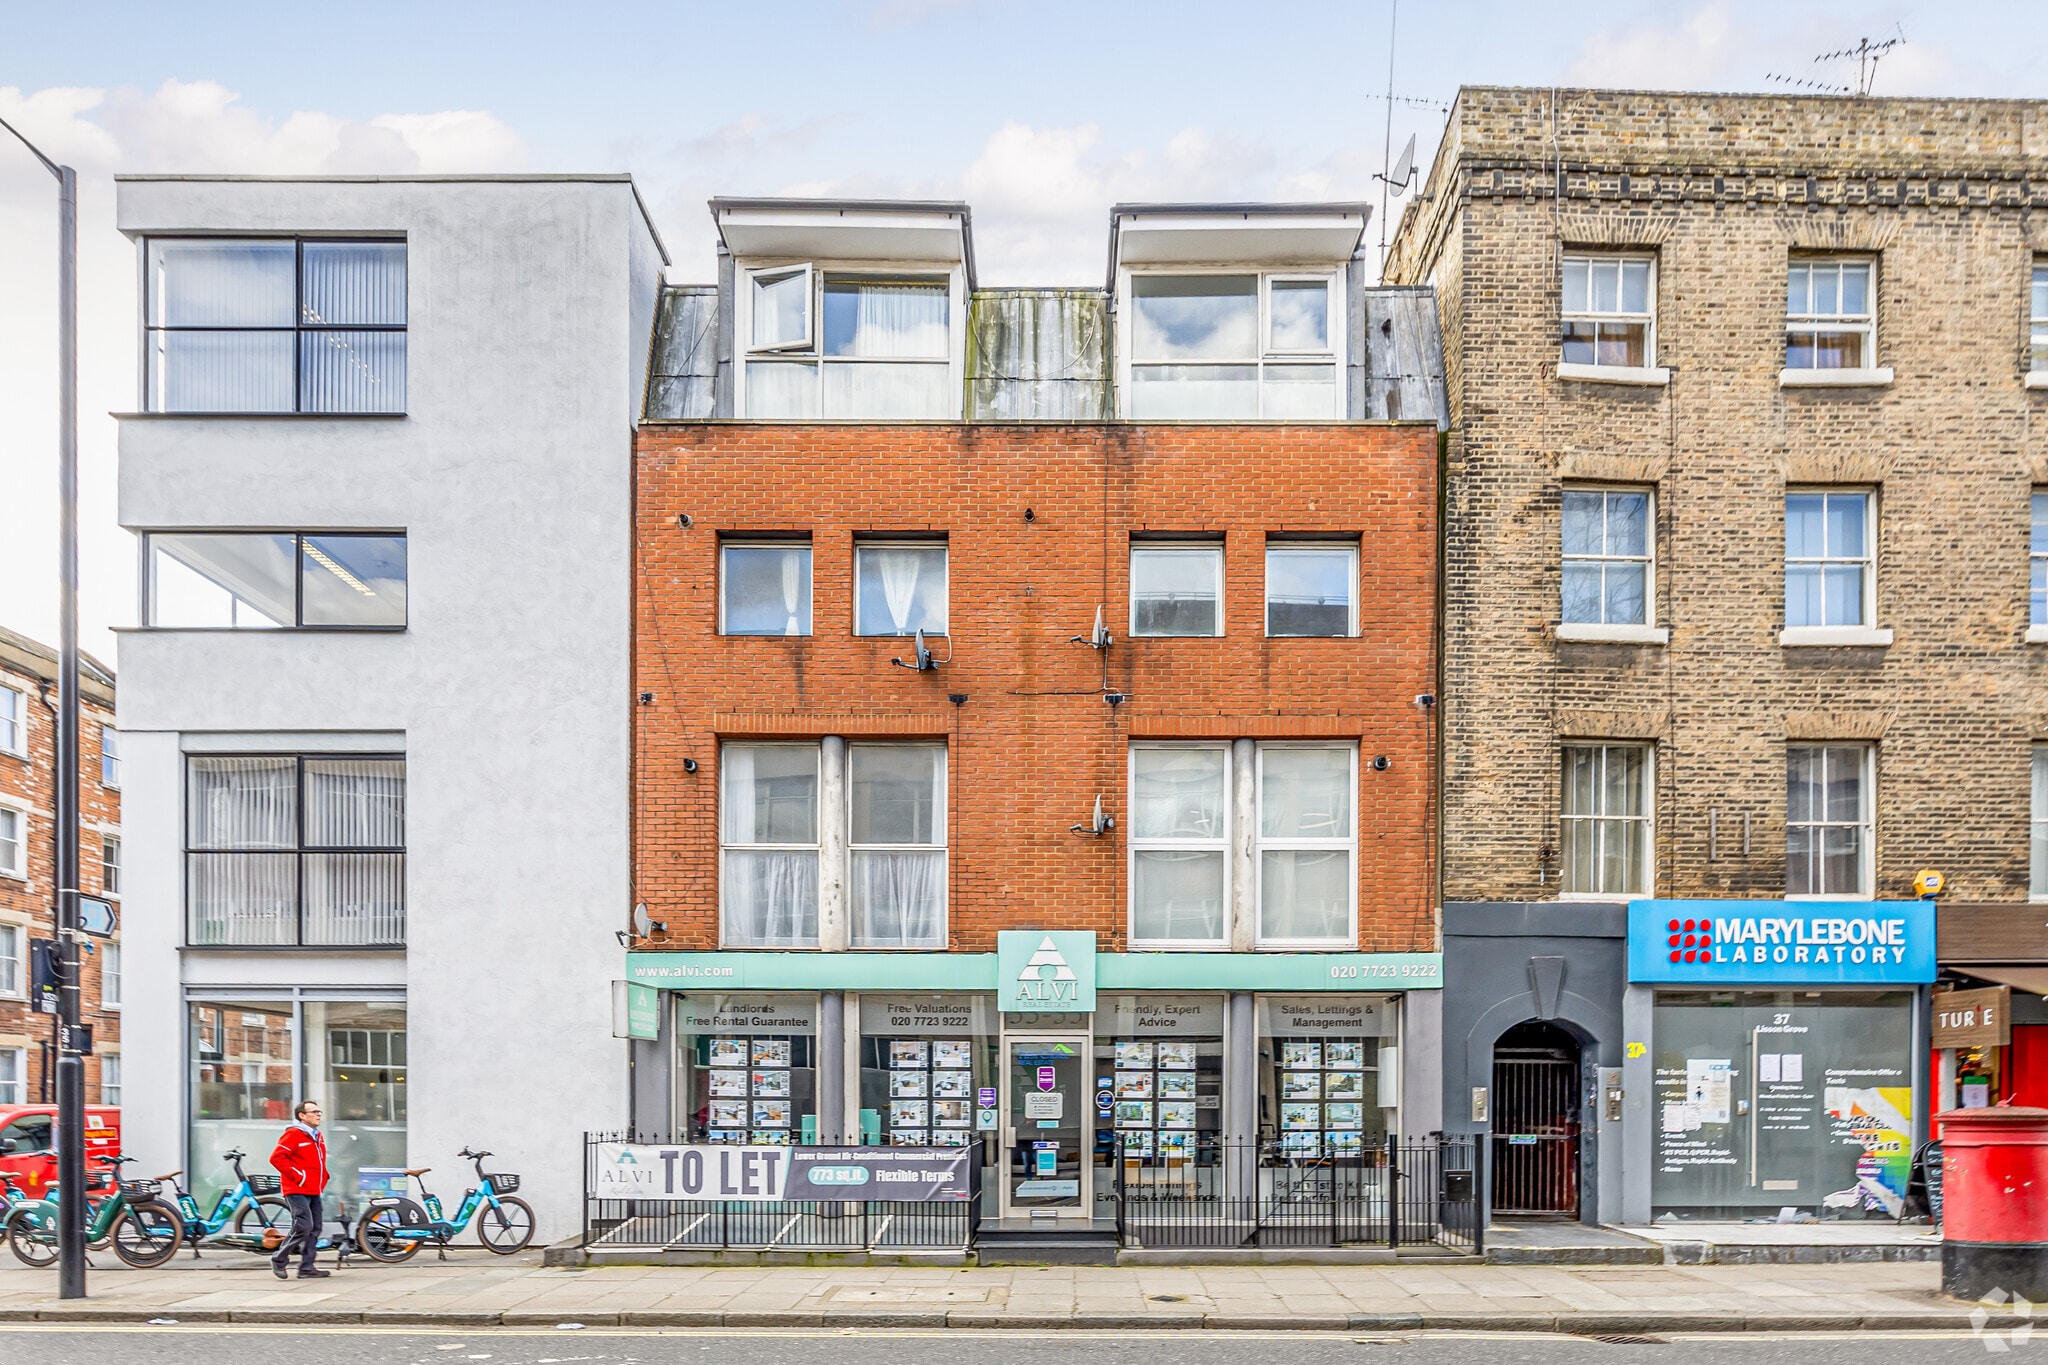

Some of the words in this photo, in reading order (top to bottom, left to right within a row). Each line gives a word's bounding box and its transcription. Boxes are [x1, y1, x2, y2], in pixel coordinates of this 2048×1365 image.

[1715, 918, 1906, 945] MARYLEBONE
[1715, 946, 1906, 964] LABORATORY
[634, 965, 734, 977] www.alvi.com
[1330, 966, 1357, 978] 020
[1362, 965, 1397, 977] 7723
[1402, 964, 1437, 977] 9222
[1016, 982, 1078, 1001] ALVI
[719, 1004, 775, 1013] Landlords
[887, 1003, 912, 1014] Free
[914, 1003, 972, 1014] Valuations
[1165, 1005, 1201, 1016] Expert
[1281, 1005, 1314, 1016] Sales,
[1317, 1005, 1362, 1016] Lettings
[1365, 1005, 1374, 1014] &
[686, 1016, 710, 1027] Free
[714, 1016, 749, 1027] Rental
[751, 1016, 809, 1027] Guarantee
[891, 1016, 911, 1026] 020
[914, 1016, 939, 1026] 7723
[942, 1016, 969, 1026] 9222
[1138, 1017, 1177, 1027] Advice
[1292, 1018, 1363, 1029] Management
[1773, 1013, 1791, 1026] 37
[1756, 1024, 1782, 1034] Lisson
[1782, 1024, 1808, 1034] Grove
[794, 1152, 816, 1161] Lower
[816, 1152, 841, 1161] Ground
[894, 1152, 935, 1161] Commercial
[601, 1170, 652, 1184] ALVI
[660, 1150, 703, 1195] TO
[720, 1151, 780, 1195] LET
[812, 1168, 834, 1182] 773
[875, 1170, 919, 1182] Flexible
[921, 1170, 955, 1182] Terms
